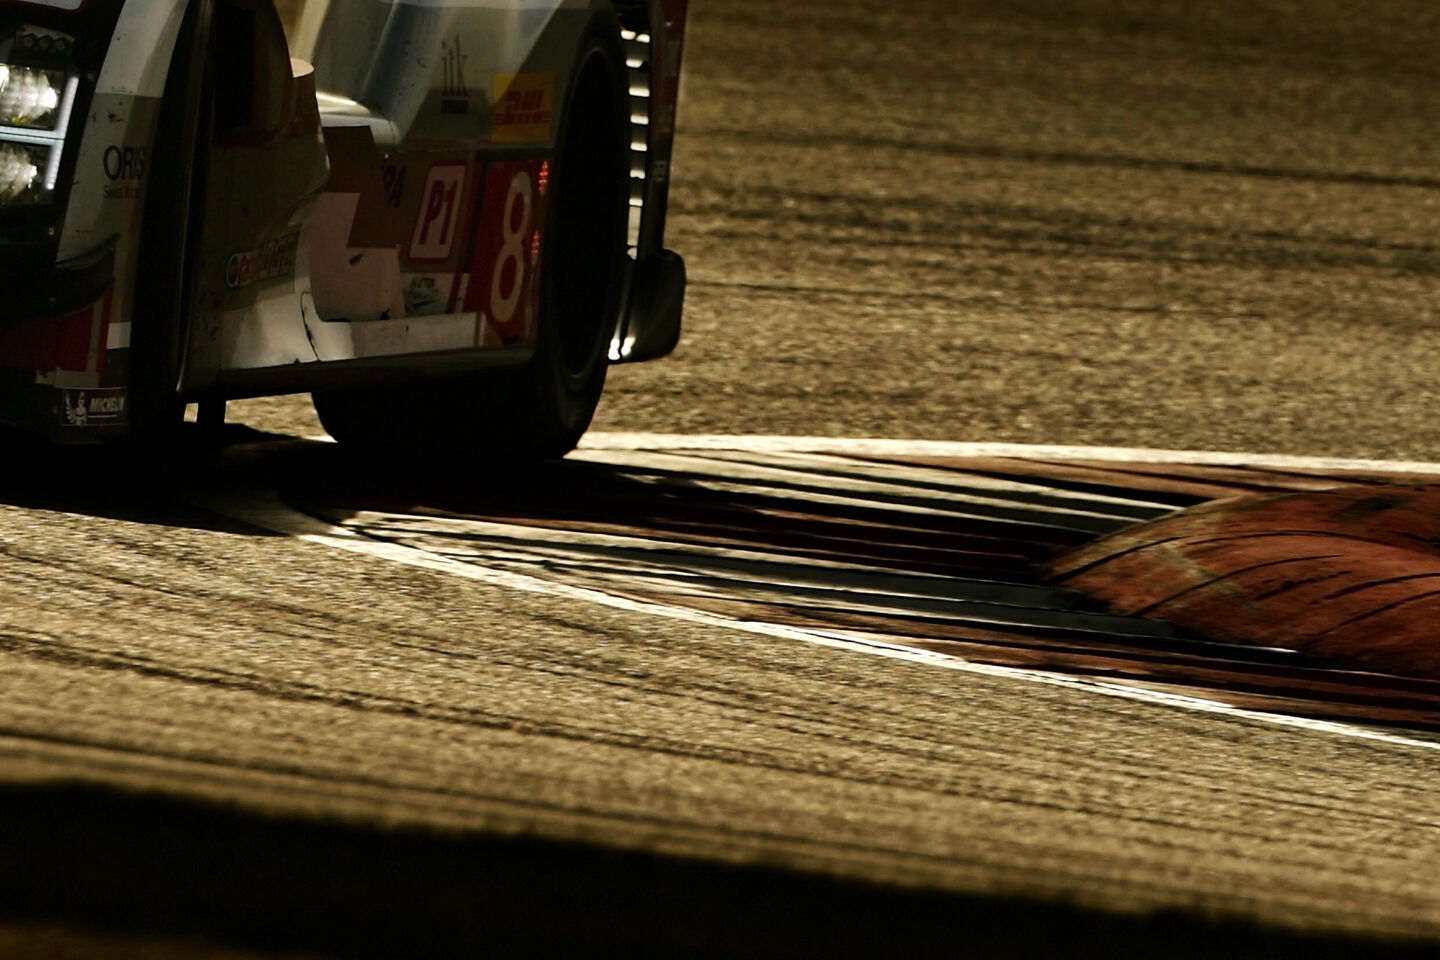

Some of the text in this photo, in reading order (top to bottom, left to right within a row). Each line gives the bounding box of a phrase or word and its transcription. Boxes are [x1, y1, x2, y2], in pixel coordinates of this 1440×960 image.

[103, 145, 147, 180] ORIS
[419, 180, 458, 245] P1
[490, 171, 532, 322] 8
